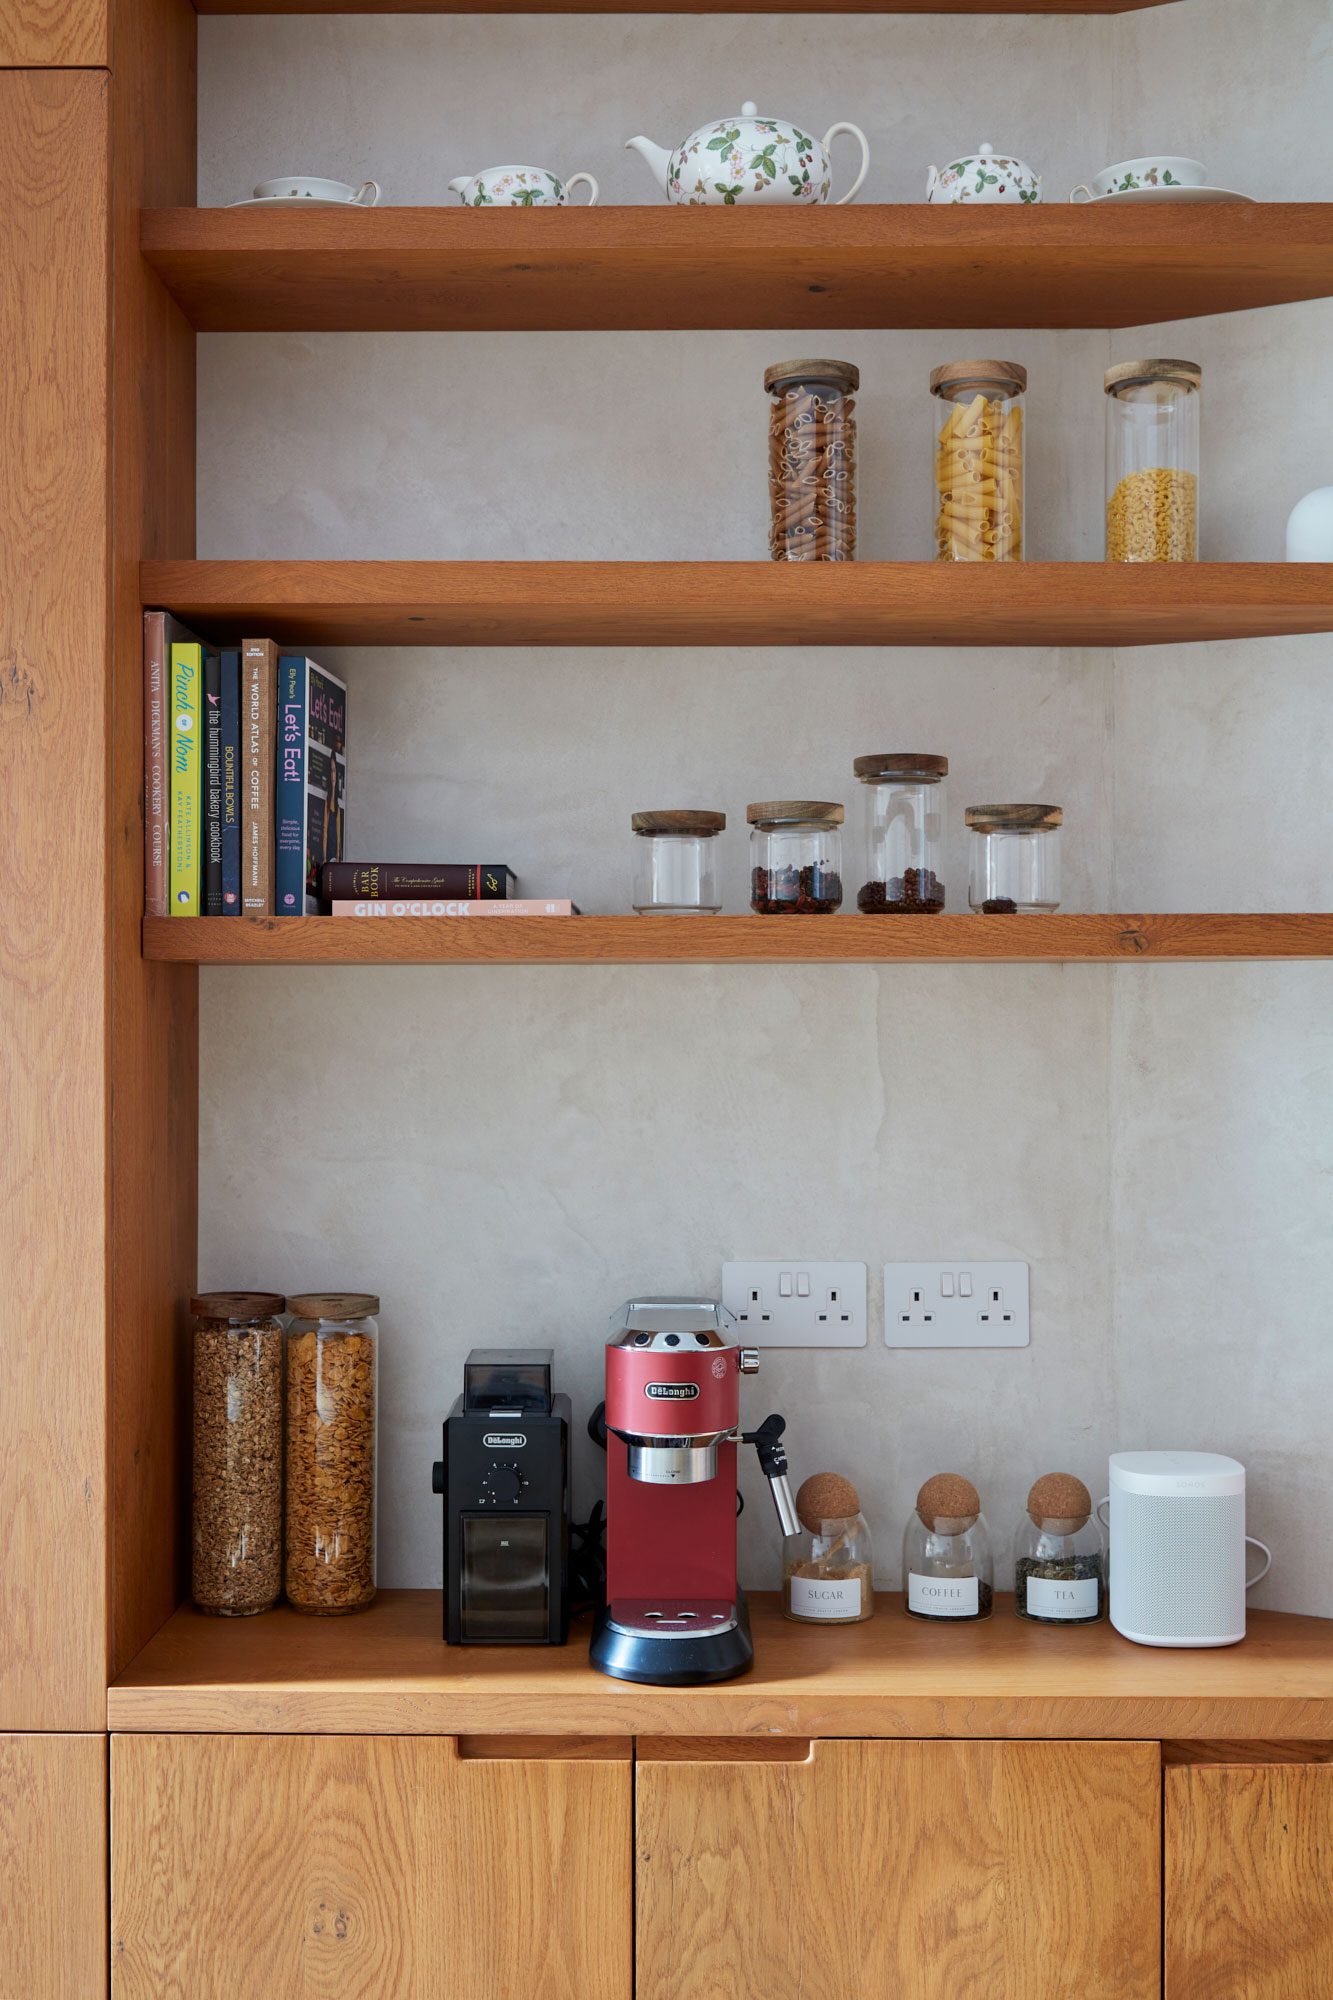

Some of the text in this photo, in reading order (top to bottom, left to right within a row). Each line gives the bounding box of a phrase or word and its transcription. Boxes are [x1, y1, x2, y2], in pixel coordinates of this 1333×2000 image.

[175, 662, 195, 712] Pinch
[250, 683, 259, 720] WORLD
[288, 668, 297, 699] Elly Pear's
[310, 685, 343, 734] Let's Eat!
[175, 733, 195, 774] Nom
[250, 723, 259, 754] ATLAS
[284, 704, 302, 782] Let's Eat!
[150, 660, 162, 867] ANITA DICKMAN'S COOKERY COURSE
[251, 757, 258, 767] OF
[207, 710, 222, 863] the hummingbird bakery cookbook
[224, 746, 235, 823] BOUNTIFUL BOWLS
[250, 770, 259, 809] COFFEE
[251, 845, 259, 887] HOFFMANN
[361, 871, 370, 892] BAR
[370, 866, 379, 897] BOOK
[354, 902, 470, 916] GIN O'CLOCK
[807, 1590, 844, 1600] SUGAR
[921, 1586, 963, 1598] COFFEE
[1053, 1590, 1075, 1600] TEA
